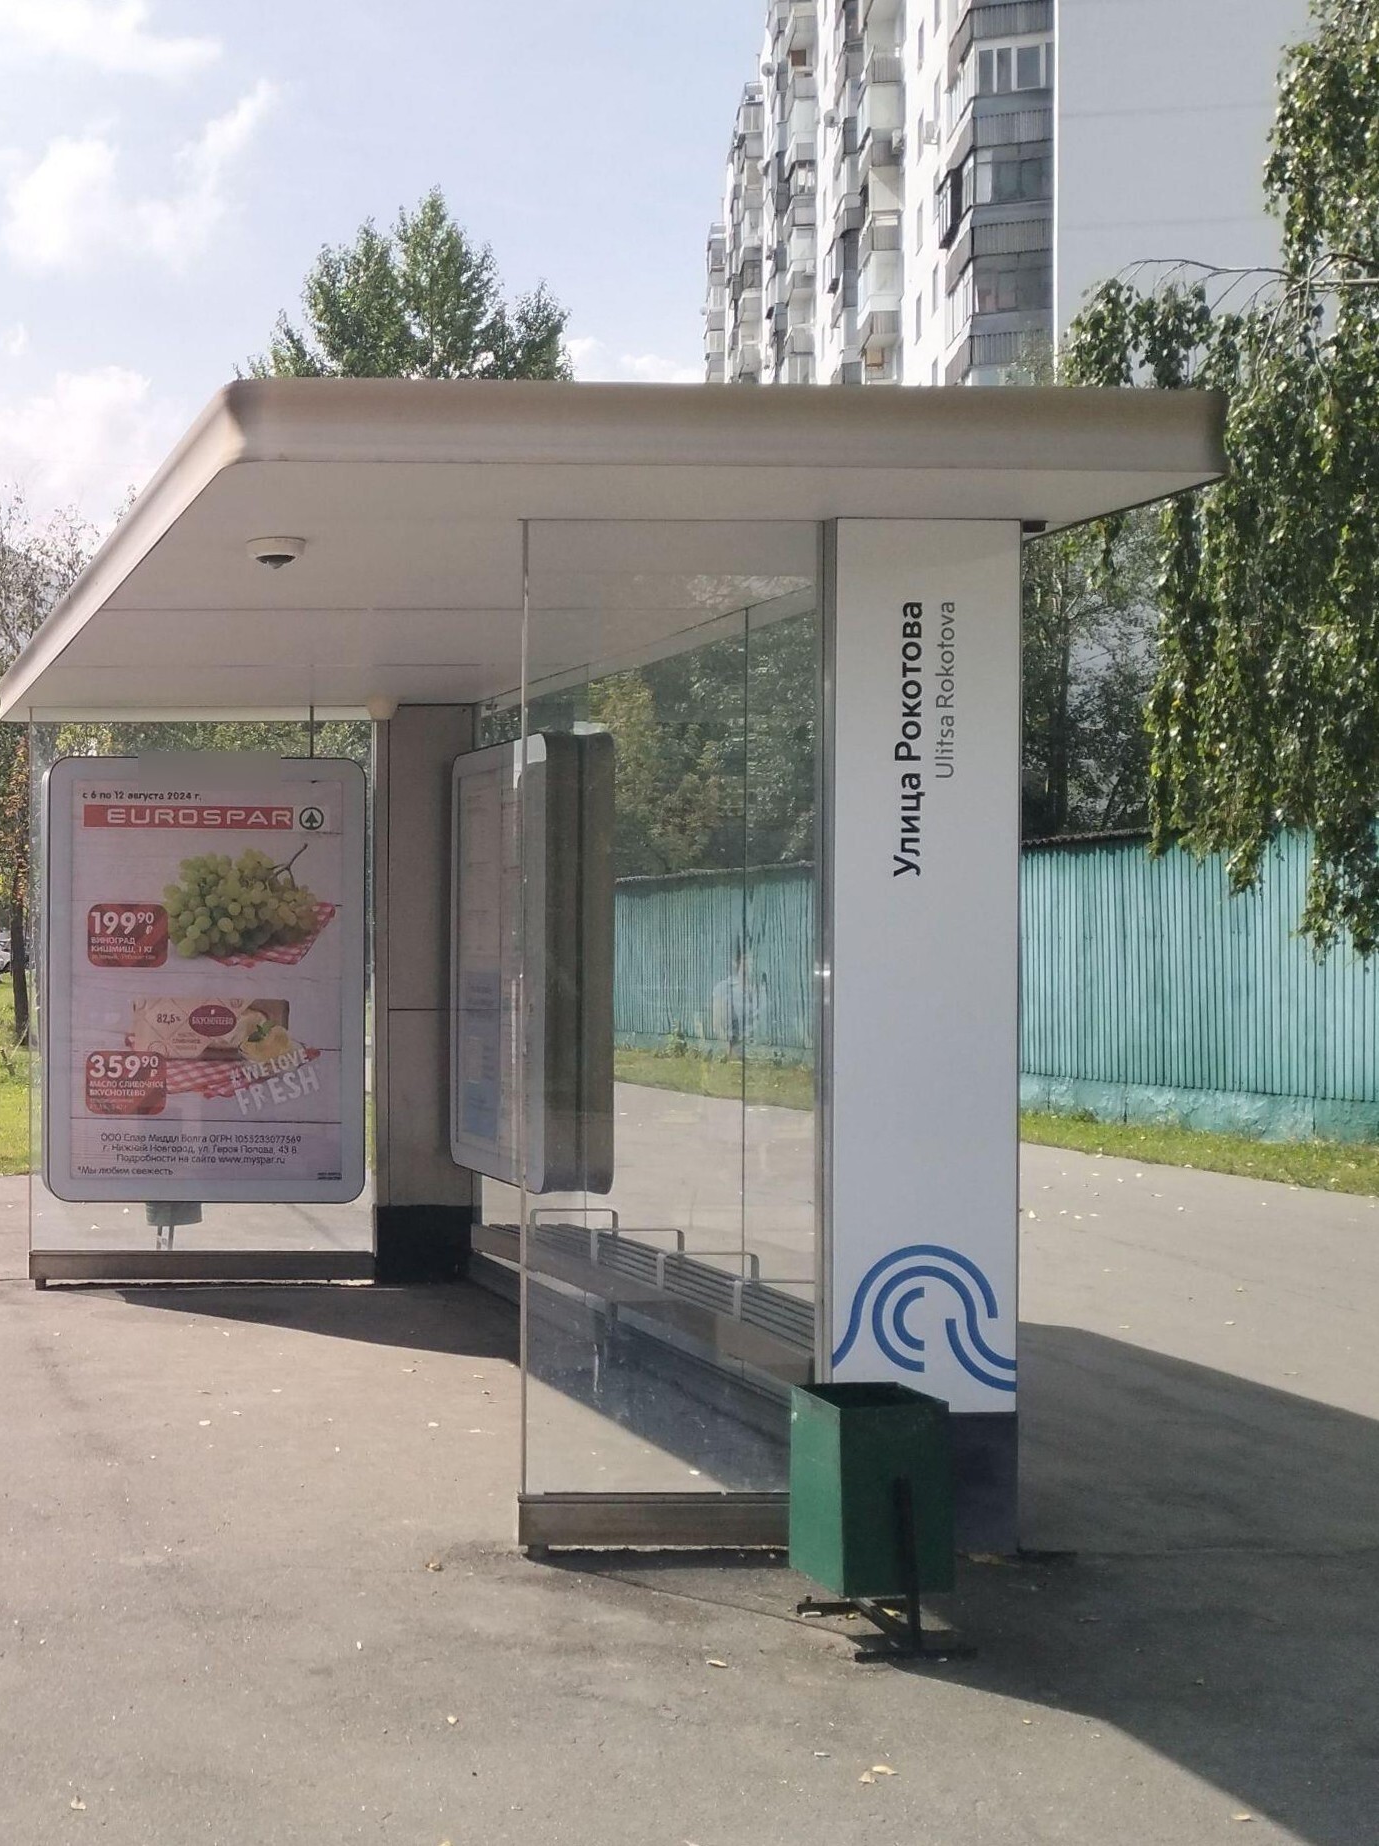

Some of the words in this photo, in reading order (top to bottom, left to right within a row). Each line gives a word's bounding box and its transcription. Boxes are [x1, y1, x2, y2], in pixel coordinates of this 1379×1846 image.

[934, 601, 955, 708] Rokotova
[894, 601, 923, 762] Рокотова
[934, 714, 954, 779] Ulitsa
[90, 791, 97, 799] 6
[114, 790, 124, 799] 12
[127, 792, 165, 801] августа
[167, 791, 192, 800] 2024
[107, 808, 292, 826] EUROSPAR
[893, 772, 925, 877] Улица
[90, 911, 137, 935] 199
[90, 936, 136, 945] ВИНОГРАД
[89, 1055, 141, 1078] 359
[234, 1065, 320, 1115] FRESH
[116, 1154, 176, 1163] Подробности
[99, 1166, 130, 1175] любим
[131, 1167, 174, 1175] свежесть
